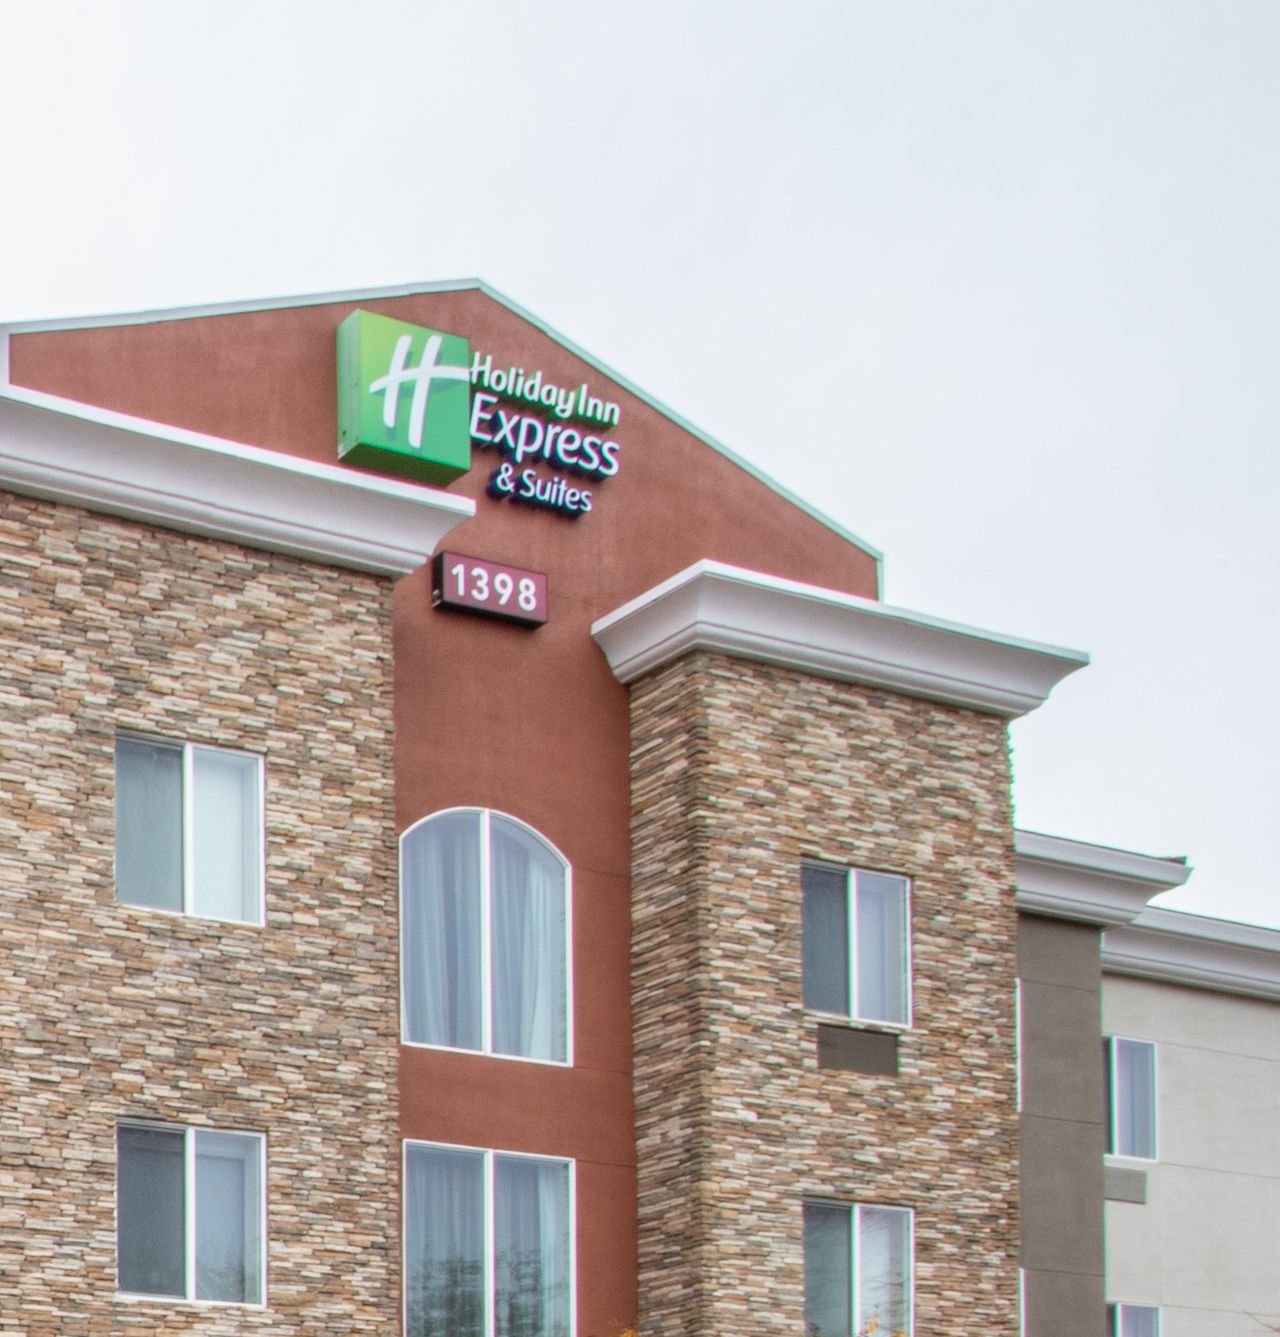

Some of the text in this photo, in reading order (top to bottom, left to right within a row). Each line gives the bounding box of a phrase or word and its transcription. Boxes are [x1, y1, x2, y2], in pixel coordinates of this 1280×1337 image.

[470, 392, 620, 476] Express
[496, 463, 592, 511] & Suites
[451, 563, 537, 612] 1398
